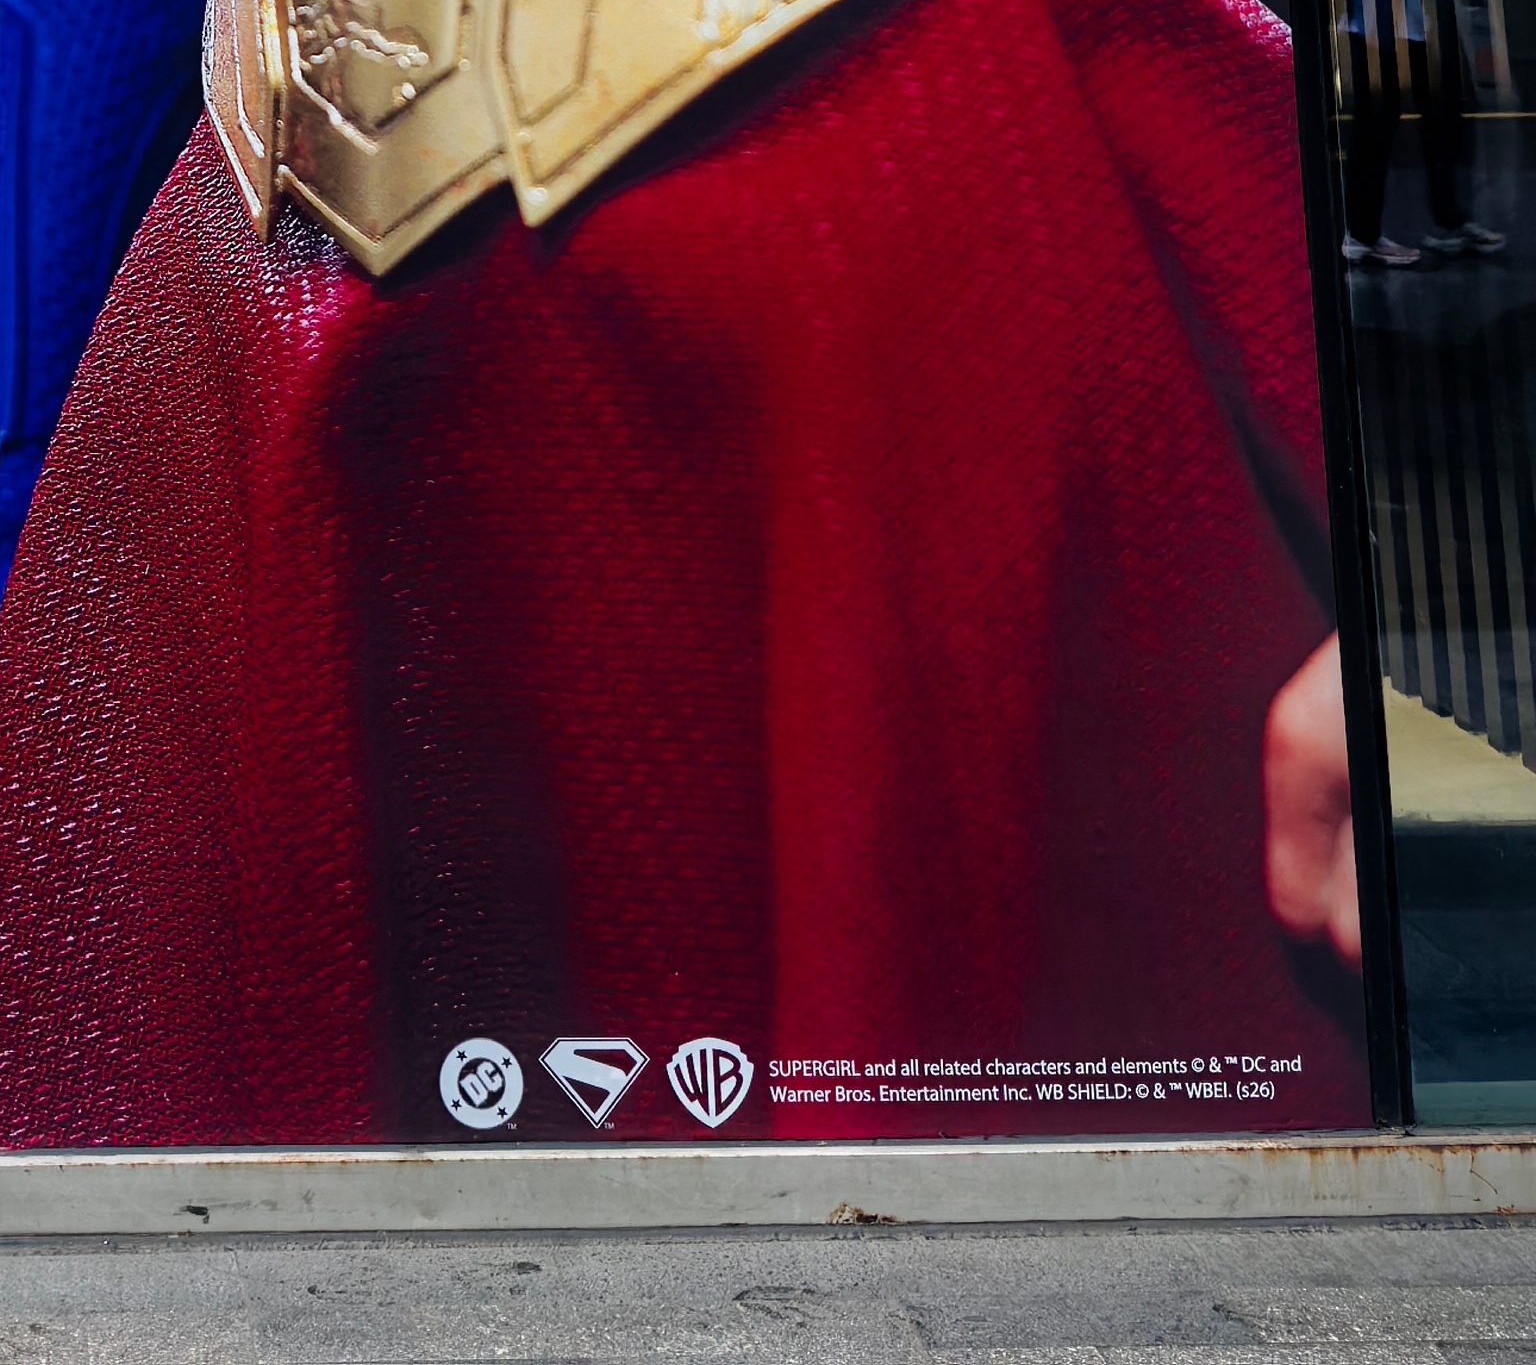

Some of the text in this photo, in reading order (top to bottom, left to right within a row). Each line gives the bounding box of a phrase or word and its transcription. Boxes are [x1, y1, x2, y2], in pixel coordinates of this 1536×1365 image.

[672, 1046, 744, 1118] WB
[769, 1059, 861, 1077] SUPERGIRL
[865, 1059, 896, 1076] and
[901, 1058, 919, 1076] all
[924, 1058, 981, 1076] related
[986, 1057, 1070, 1075] characters
[1076, 1057, 1106, 1074] and
[1111, 1056, 1187, 1074] elements
[1209, 1056, 1222, 1072] &
[1241, 1056, 1266, 1072] DC
[1270, 1055, 1302, 1072] and
[459, 1060, 505, 1108] DC
[769, 1085, 831, 1103] Warner
[835, 1085, 875, 1102] Bros.
[879, 1084, 999, 1102] Entertainment
[1003, 1084, 1032, 1101] Inc.
[1036, 1084, 1063, 1100] WB
[1068, 1083, 1132, 1100] SHIELD:
[1153, 1082, 1166, 1098] &
[1185, 1082, 1232, 1099] WBEI.
[1237, 1080, 1275, 1100] (s26)
